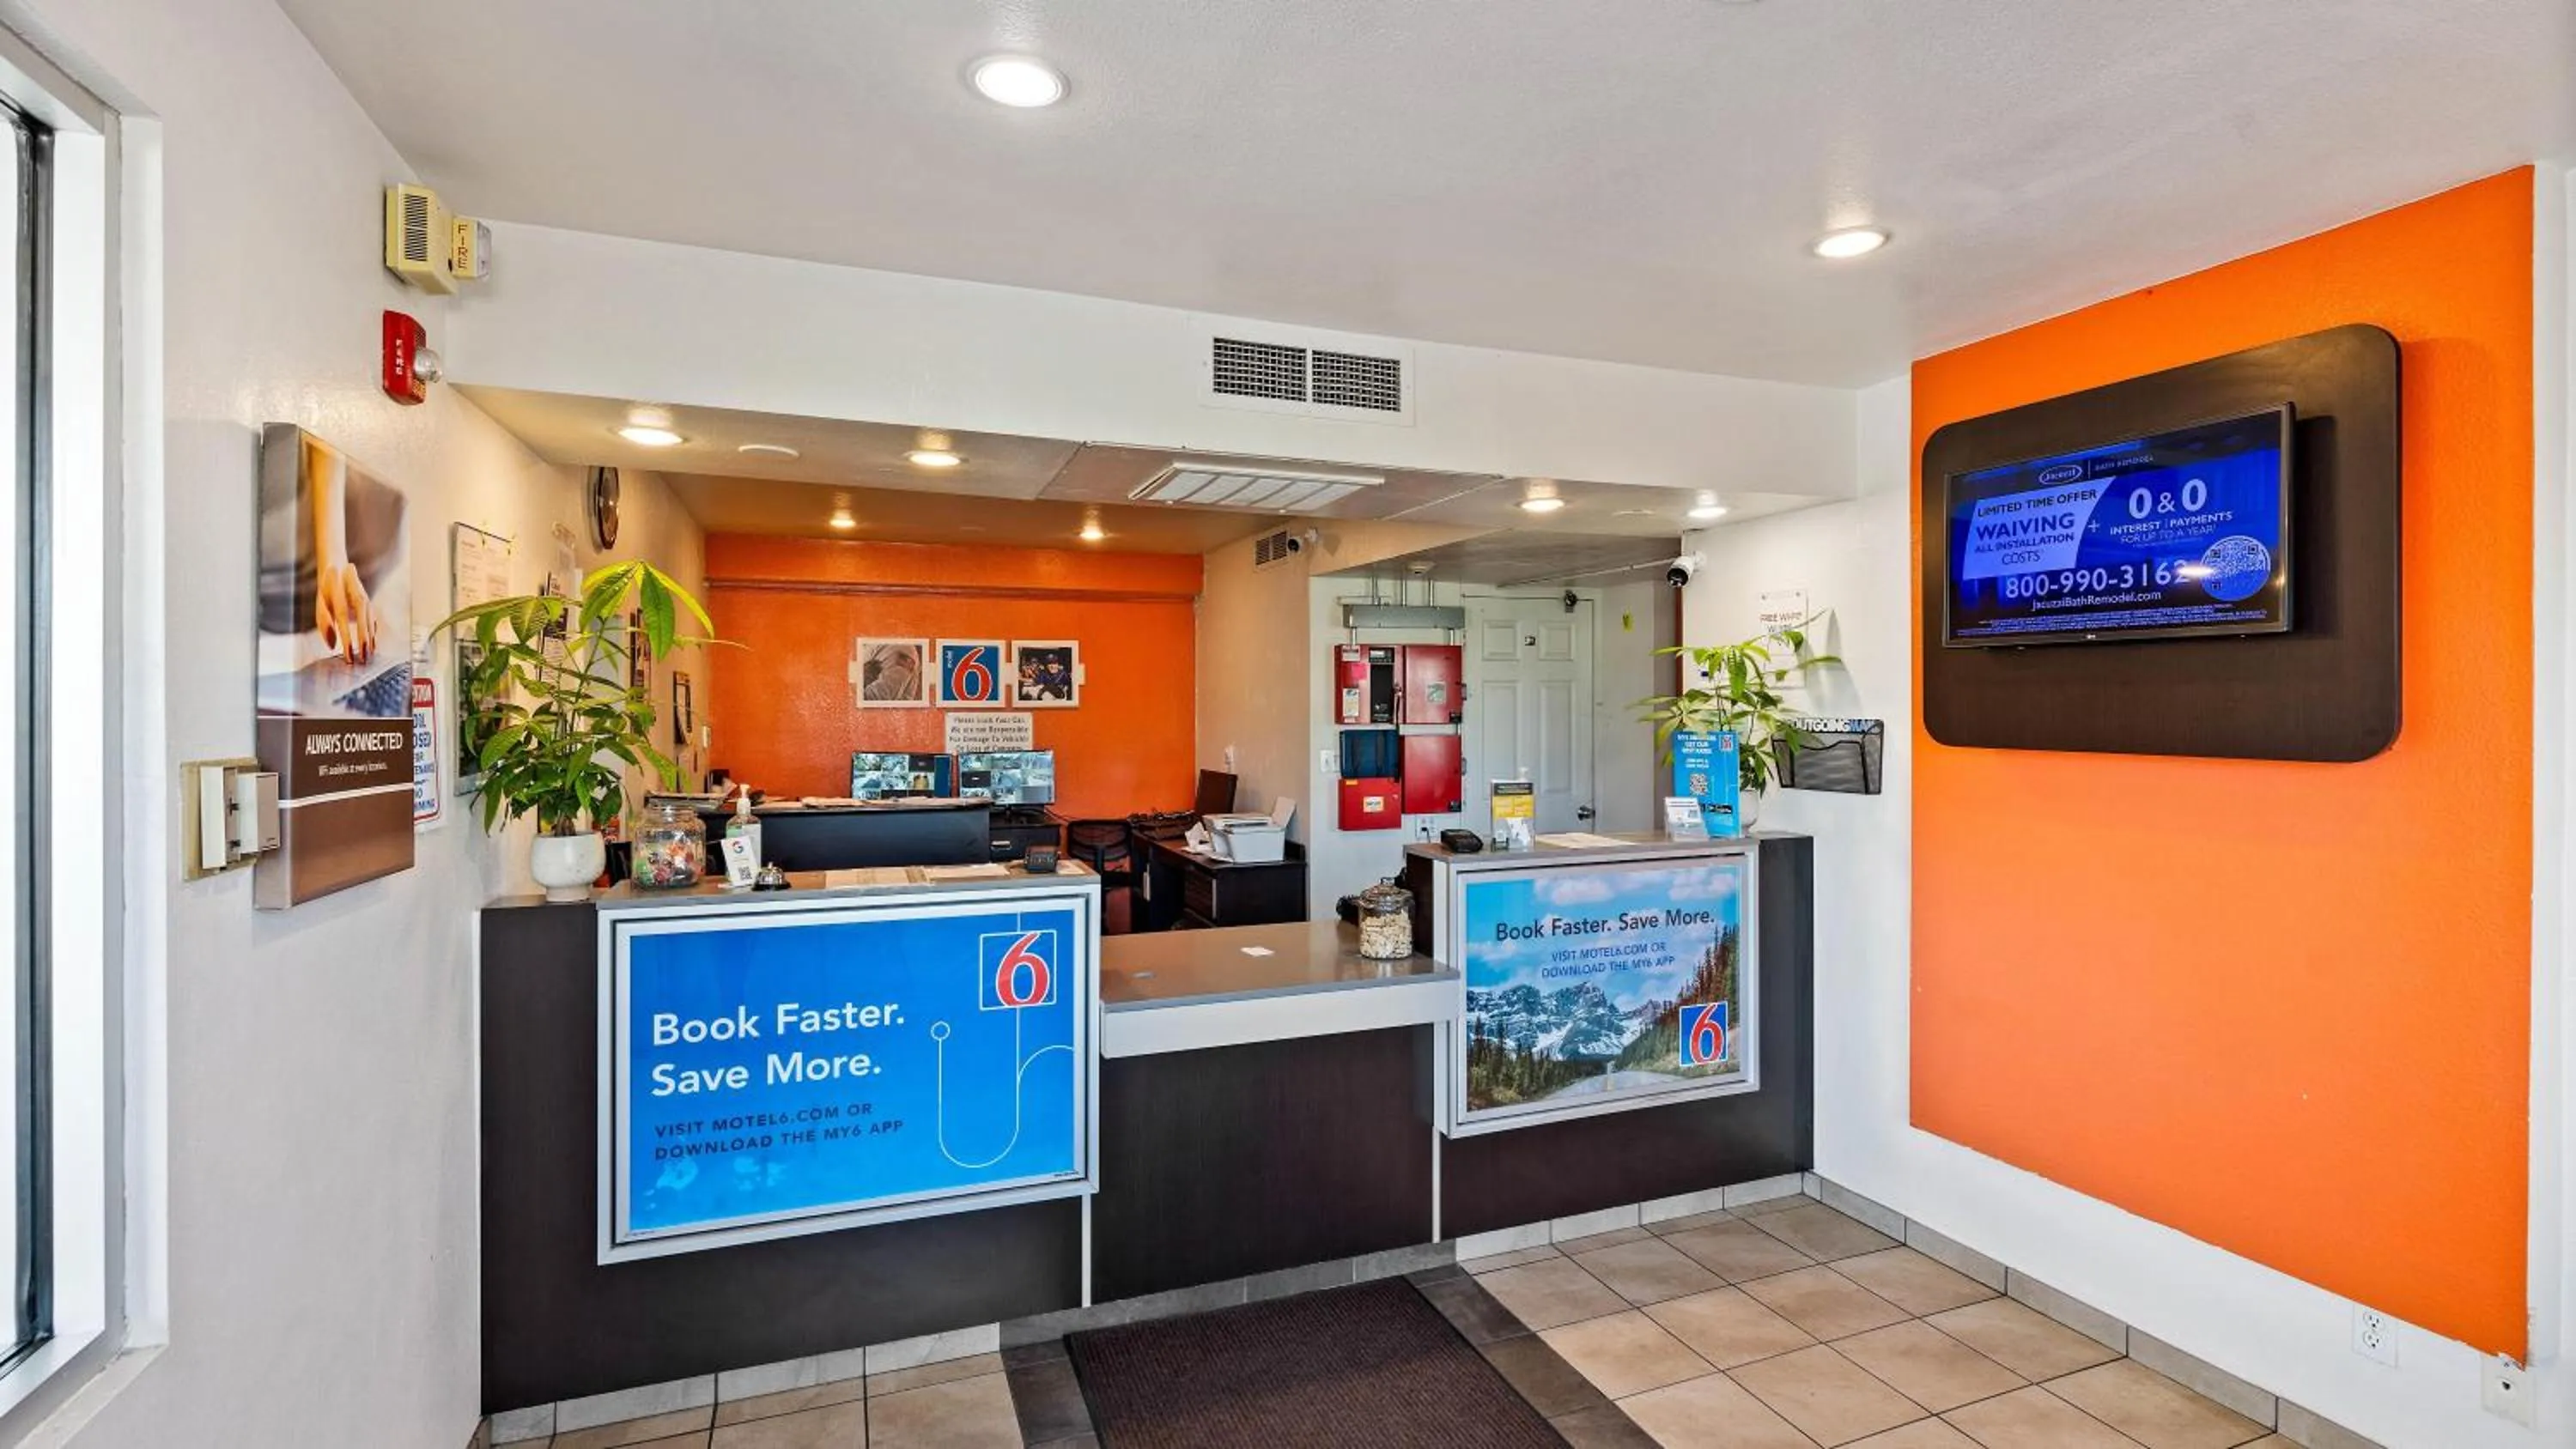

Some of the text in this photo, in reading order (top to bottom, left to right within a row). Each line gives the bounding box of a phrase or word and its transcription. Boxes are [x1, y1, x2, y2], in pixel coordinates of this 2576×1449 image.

[458, 224, 468, 270] FIRE
[1978, 488, 2097, 518] LIMITED TIME OFFER
[2129, 478, 2208, 519] 0 & 0
[1976, 512, 2075, 542] WAIVING
[2110, 511, 2233, 536] INTEREST PAYMENTS
[2120, 533, 2141, 544] FOR
[2142, 531, 2158, 543] UP
[1975, 531, 2075, 554] ALL INSTALLATION
[2005, 559, 2191, 599] 800-990-3162
[2032, 591, 2162, 612] JacuzziBathRemodel.com
[951, 646, 993, 700] 6
[306, 732, 404, 755] ALWAYS CONNECTED
[1496, 908, 1716, 942] Book Faster. Save More.
[995, 931, 1051, 1007] 6
[1541, 955, 1675, 979] DOWNLOAD THE MY6 APP
[1552, 942, 1667, 962] VISIT MOTEL6.COM OR
[652, 1001, 905, 1046] Book Faster.
[1688, 1002, 1725, 1065] 6
[651, 1052, 882, 1097] Save More.
[654, 1103, 873, 1138] VISIT MOTEL6.COM OR
[654, 1119, 904, 1161] DOWNLOAD THE MY6 APP
